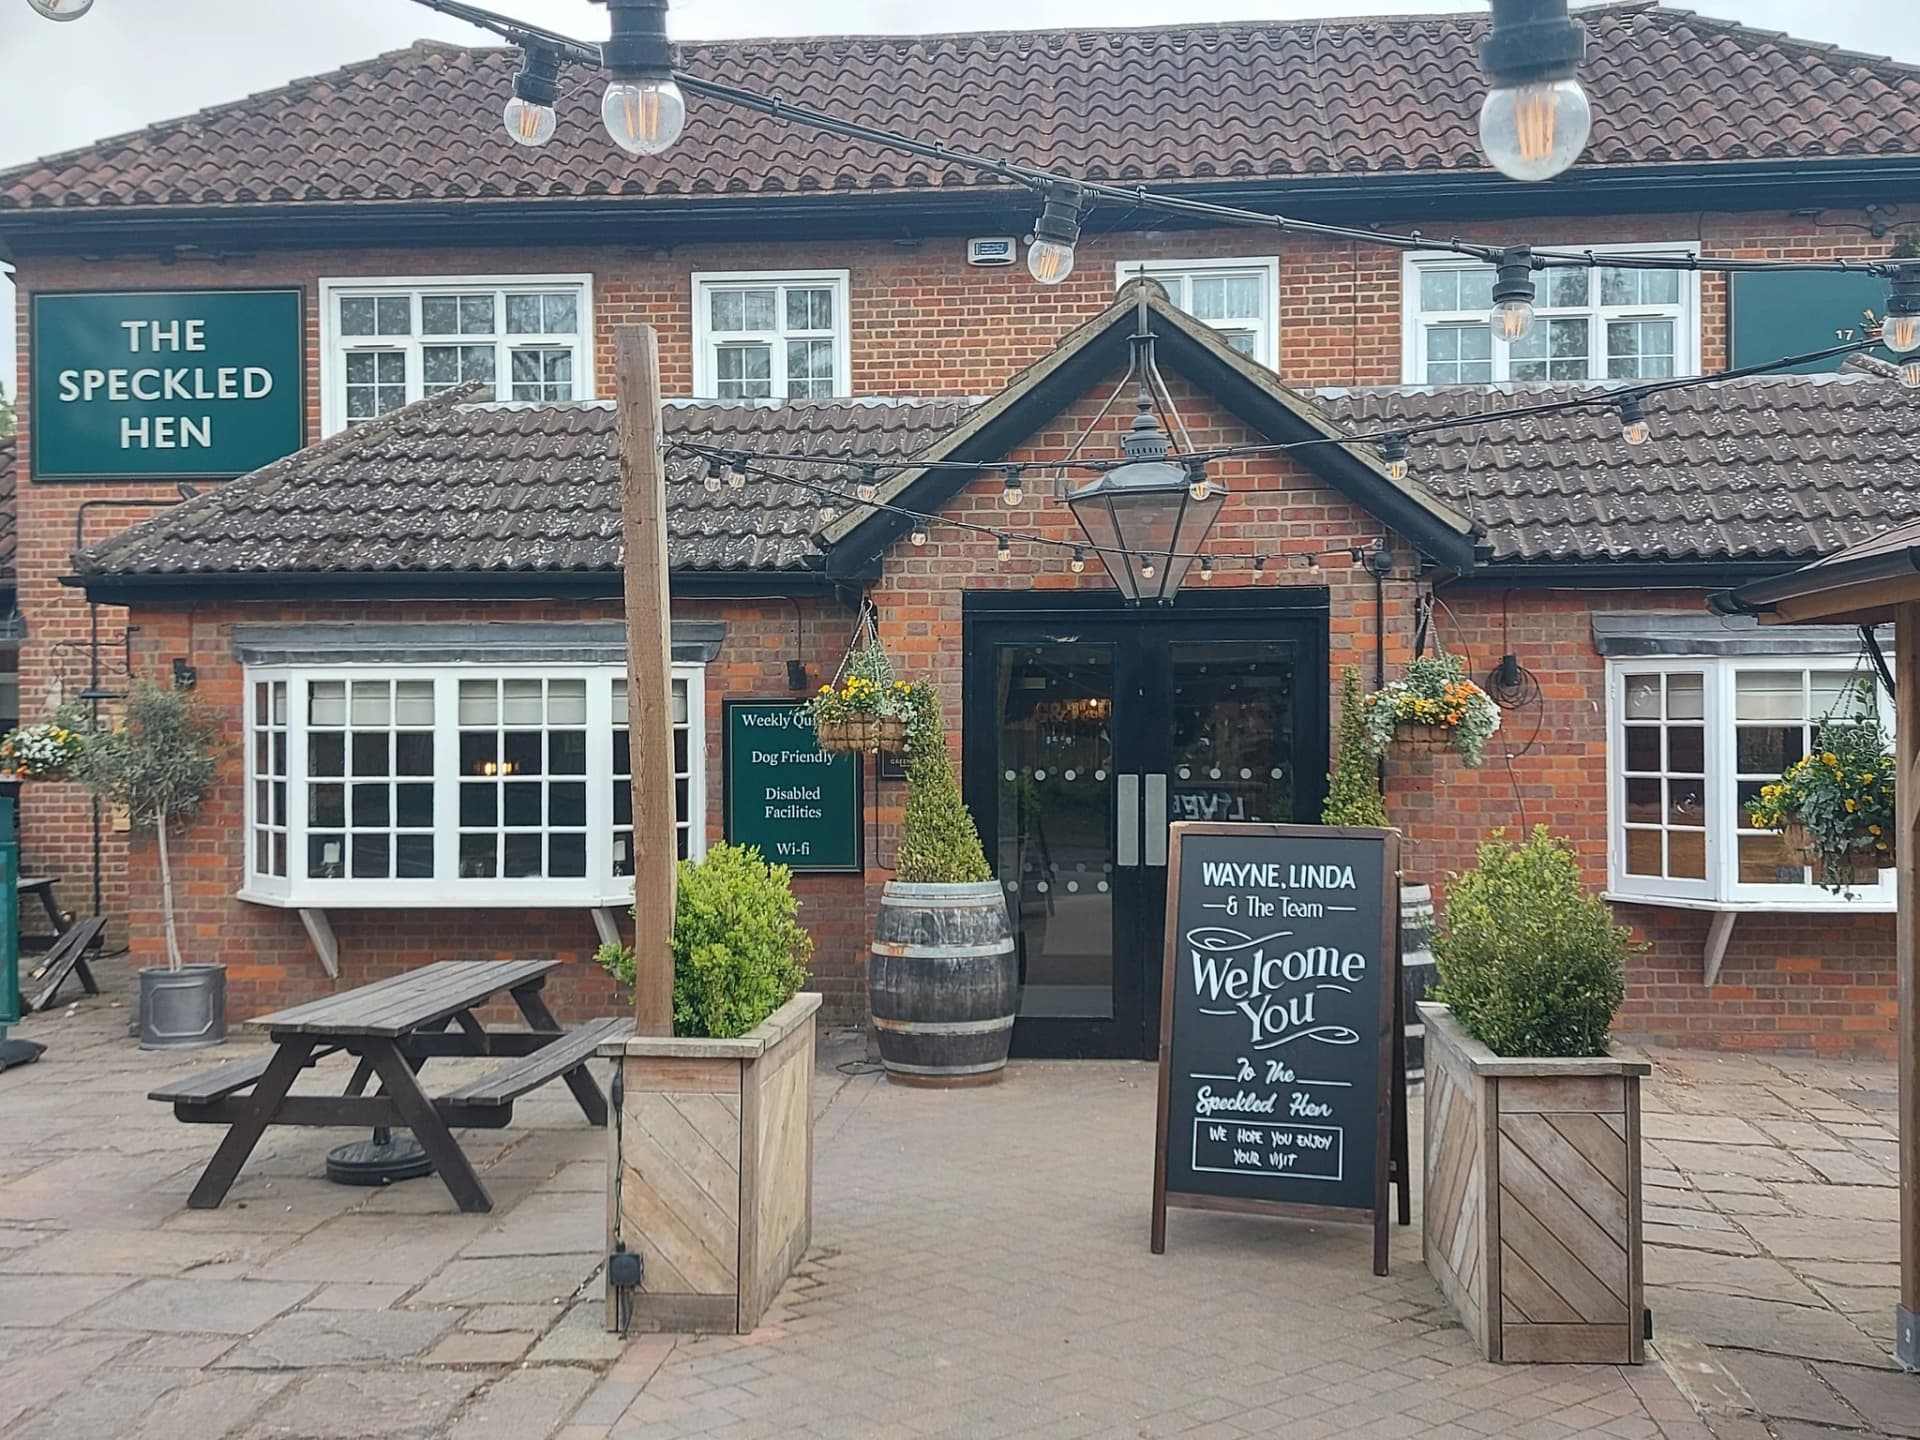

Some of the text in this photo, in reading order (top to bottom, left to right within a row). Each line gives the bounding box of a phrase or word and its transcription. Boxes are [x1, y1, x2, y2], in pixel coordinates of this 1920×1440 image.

[120, 320, 206, 351] THE
[1835, 329, 1854, 341] 17
[58, 367, 273, 402] SPECKLED
[120, 416, 212, 449] HEN
[741, 713, 816, 730] Weekly Qui
[751, 751, 835, 766] Dog Friendly
[764, 786, 821, 801] Disabled
[764, 806, 822, 819] Facilities
[776, 842, 811, 856] Wi-fi
[1290, 864, 1357, 889] LINDA
[1226, 896, 1323, 918] & The Team
[1190, 946, 1366, 1001] Welcome
[1236, 992, 1316, 1042] You
[1236, 1057, 1296, 1085] To The
[1195, 1085, 1333, 1117] Speckled Hen
[1209, 1126, 1333, 1150] WE HOPE YOU ENJOY
[1233, 1149, 1298, 1170] YOUR VISIT
